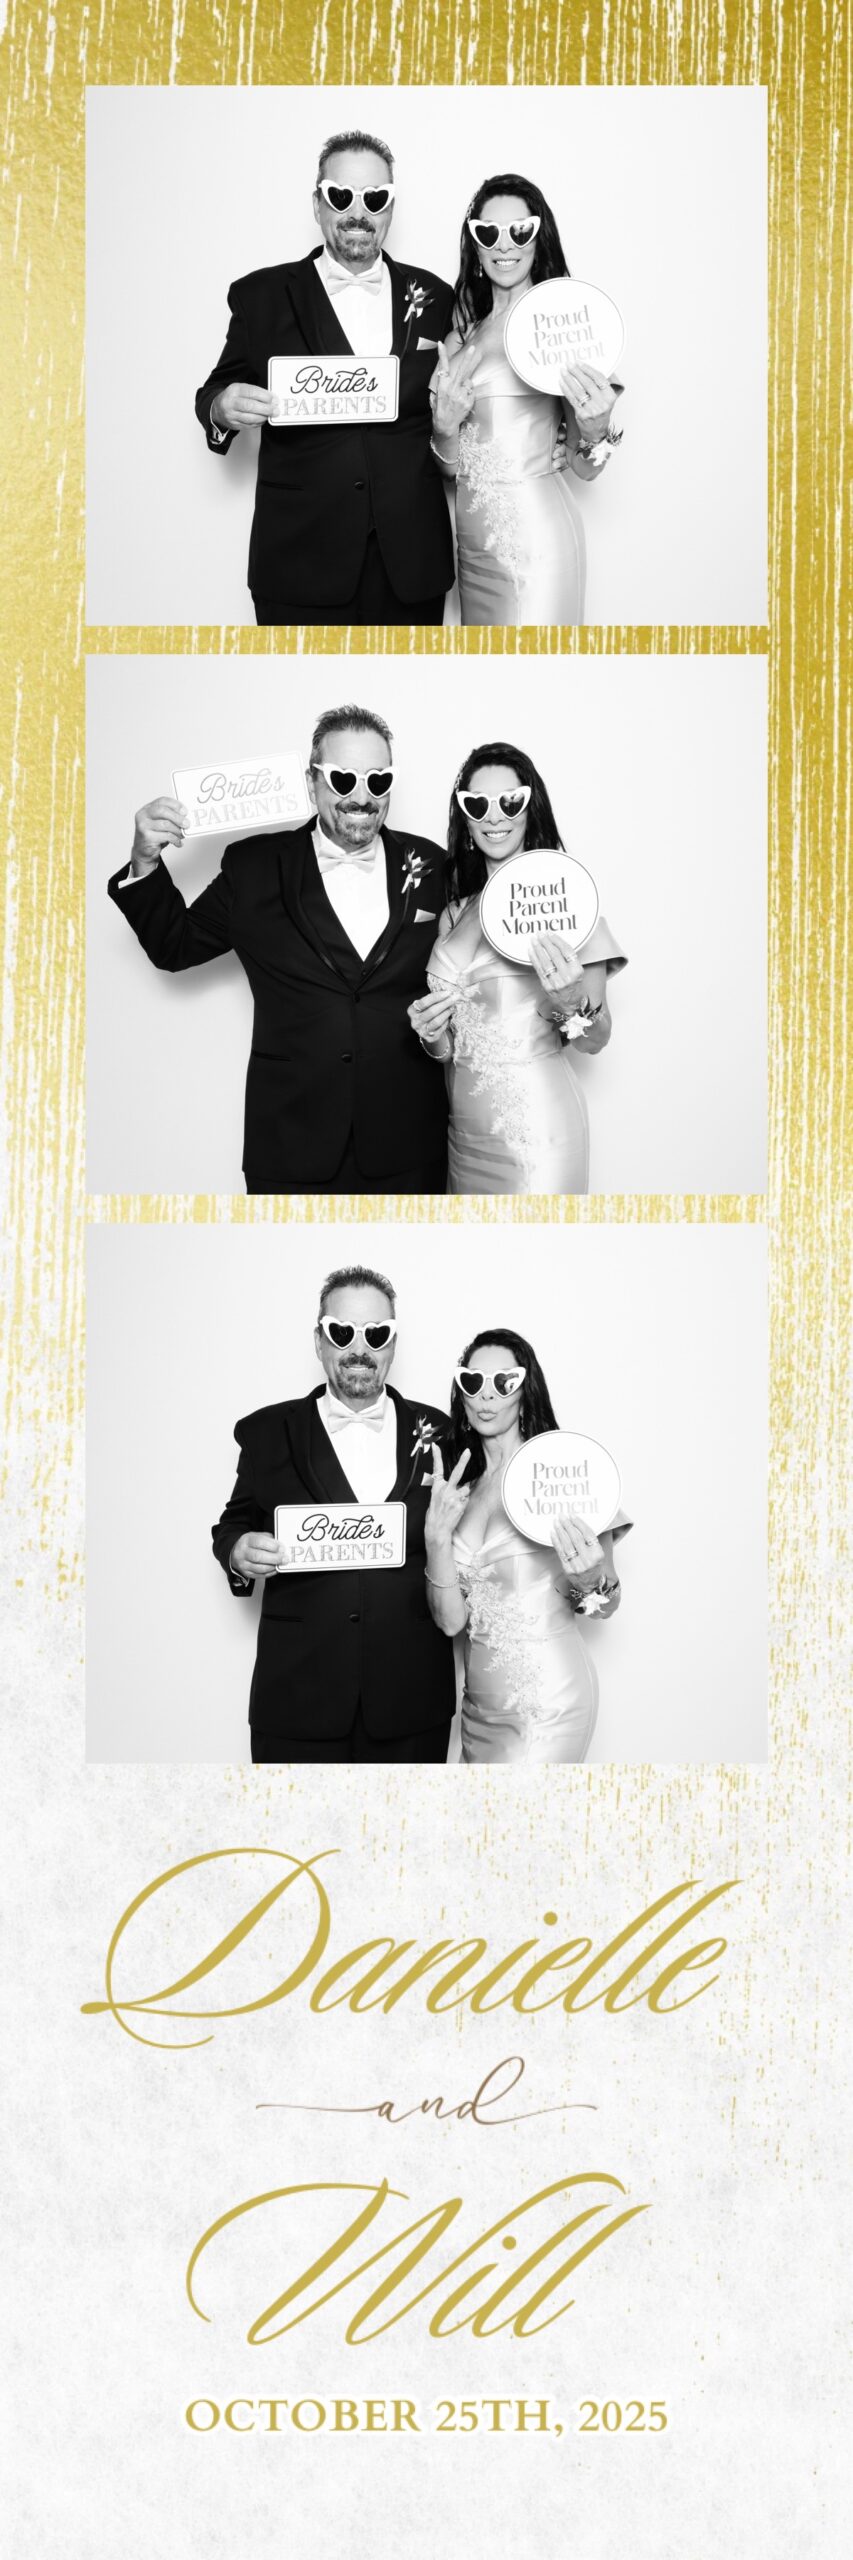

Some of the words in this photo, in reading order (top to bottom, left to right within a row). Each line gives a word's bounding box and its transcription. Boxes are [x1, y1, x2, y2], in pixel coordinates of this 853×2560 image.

[533, 304, 590, 331] Proud
[534, 325, 594, 349] Parent
[528, 341, 605, 369] Moment
[281, 395, 387, 417] PARENTS
[192, 793, 298, 827] PARENTS
[510, 876, 566, 900] Proud
[509, 897, 568, 918] Parent
[502, 914, 578, 936] Moment
[533, 1459, 588, 1480] Proud
[531, 1480, 591, 1498] Parent
[523, 1497, 600, 1517] Moment
[289, 1541, 394, 1563] PARENTS
